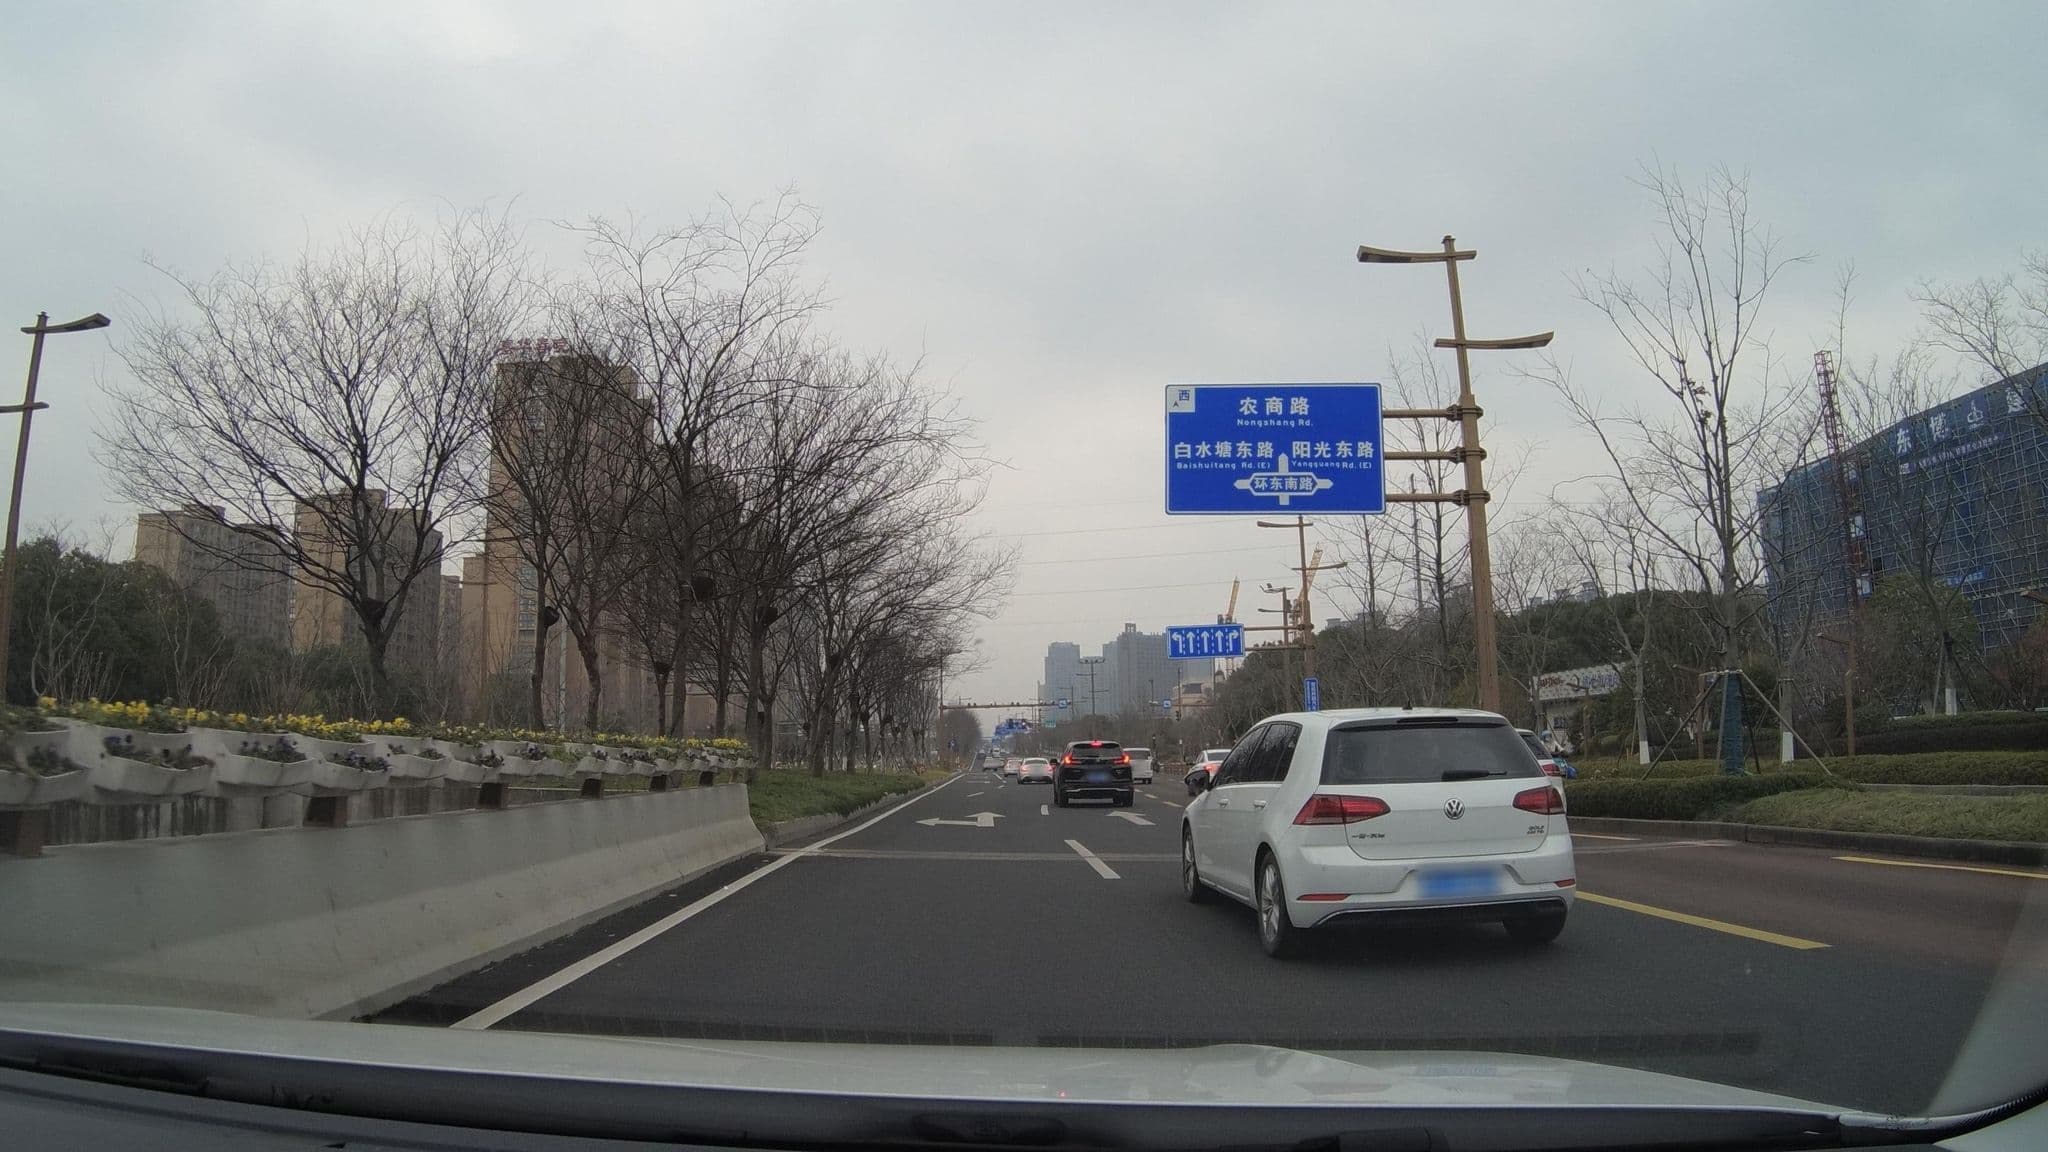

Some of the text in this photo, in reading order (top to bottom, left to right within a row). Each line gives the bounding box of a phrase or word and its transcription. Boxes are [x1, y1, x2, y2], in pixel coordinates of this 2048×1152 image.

[1178, 389, 1190, 401] 西
[1239, 396, 1310, 415] 农商路
[1237, 418, 1313, 428] Nongshang Rd.
[1174, 441, 1274, 459] 白水塘东路
[1292, 441, 1374, 458] 阳光东路
[1176, 462, 1236, 470] Baishuitang
[1291, 460, 1340, 469] Yangguang
[1254, 476, 1313, 490] 环东南路
